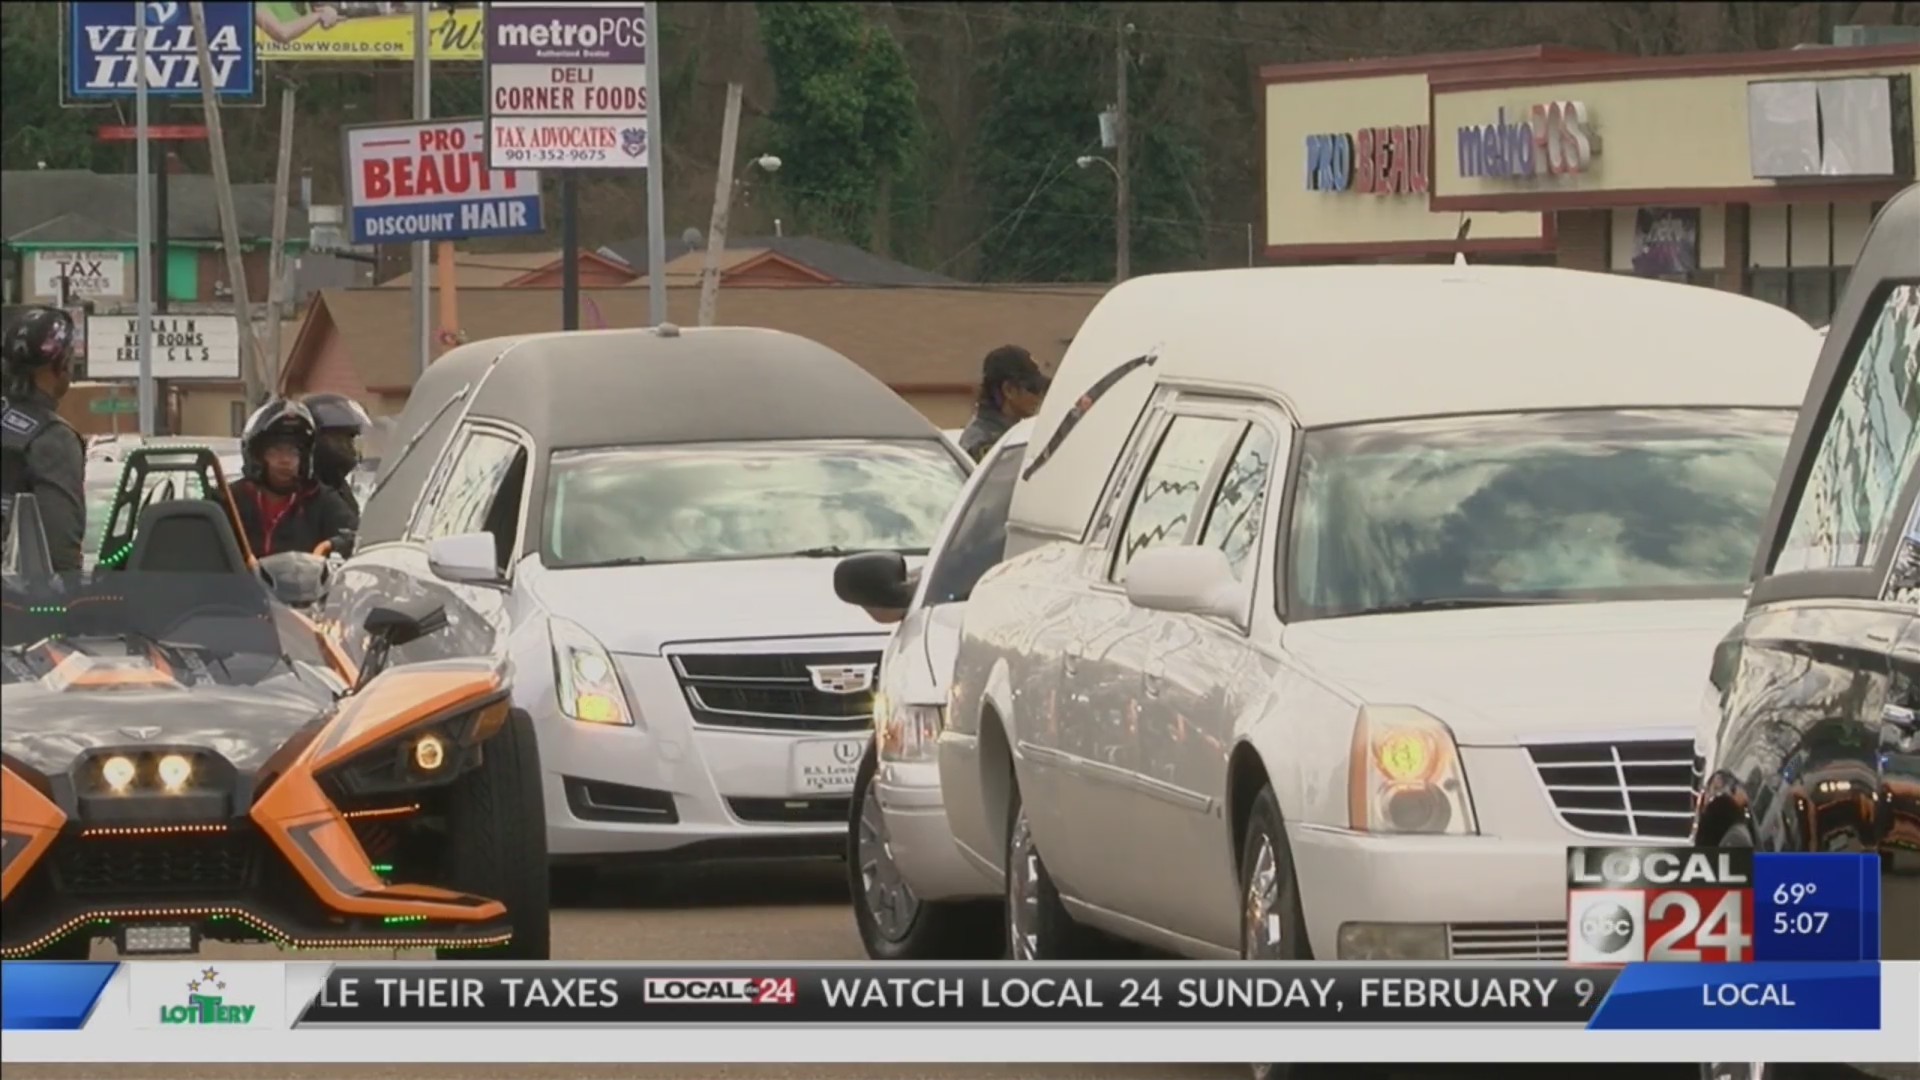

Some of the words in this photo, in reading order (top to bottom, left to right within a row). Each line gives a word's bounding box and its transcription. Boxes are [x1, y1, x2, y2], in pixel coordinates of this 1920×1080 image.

[84, 25, 242, 51] VILLA
[497, 17, 647, 47] metroPCS
[86, 55, 241, 88] INN
[551, 67, 594, 84] DELI
[495, 86, 574, 110] CORNER
[585, 86, 647, 110] FOODS
[419, 127, 466, 152] PRO
[496, 126, 526, 149] TAX
[530, 126, 617, 149] ADVOCATES
[505, 149, 606, 161] 901-352-9675
[1305, 132, 1352, 192] PRO
[365, 212, 455, 237] DISCOUNT
[460, 200, 528, 231] HAIR
[56, 260, 102, 277] TAX
[157, 333, 204, 347] ROOMS
